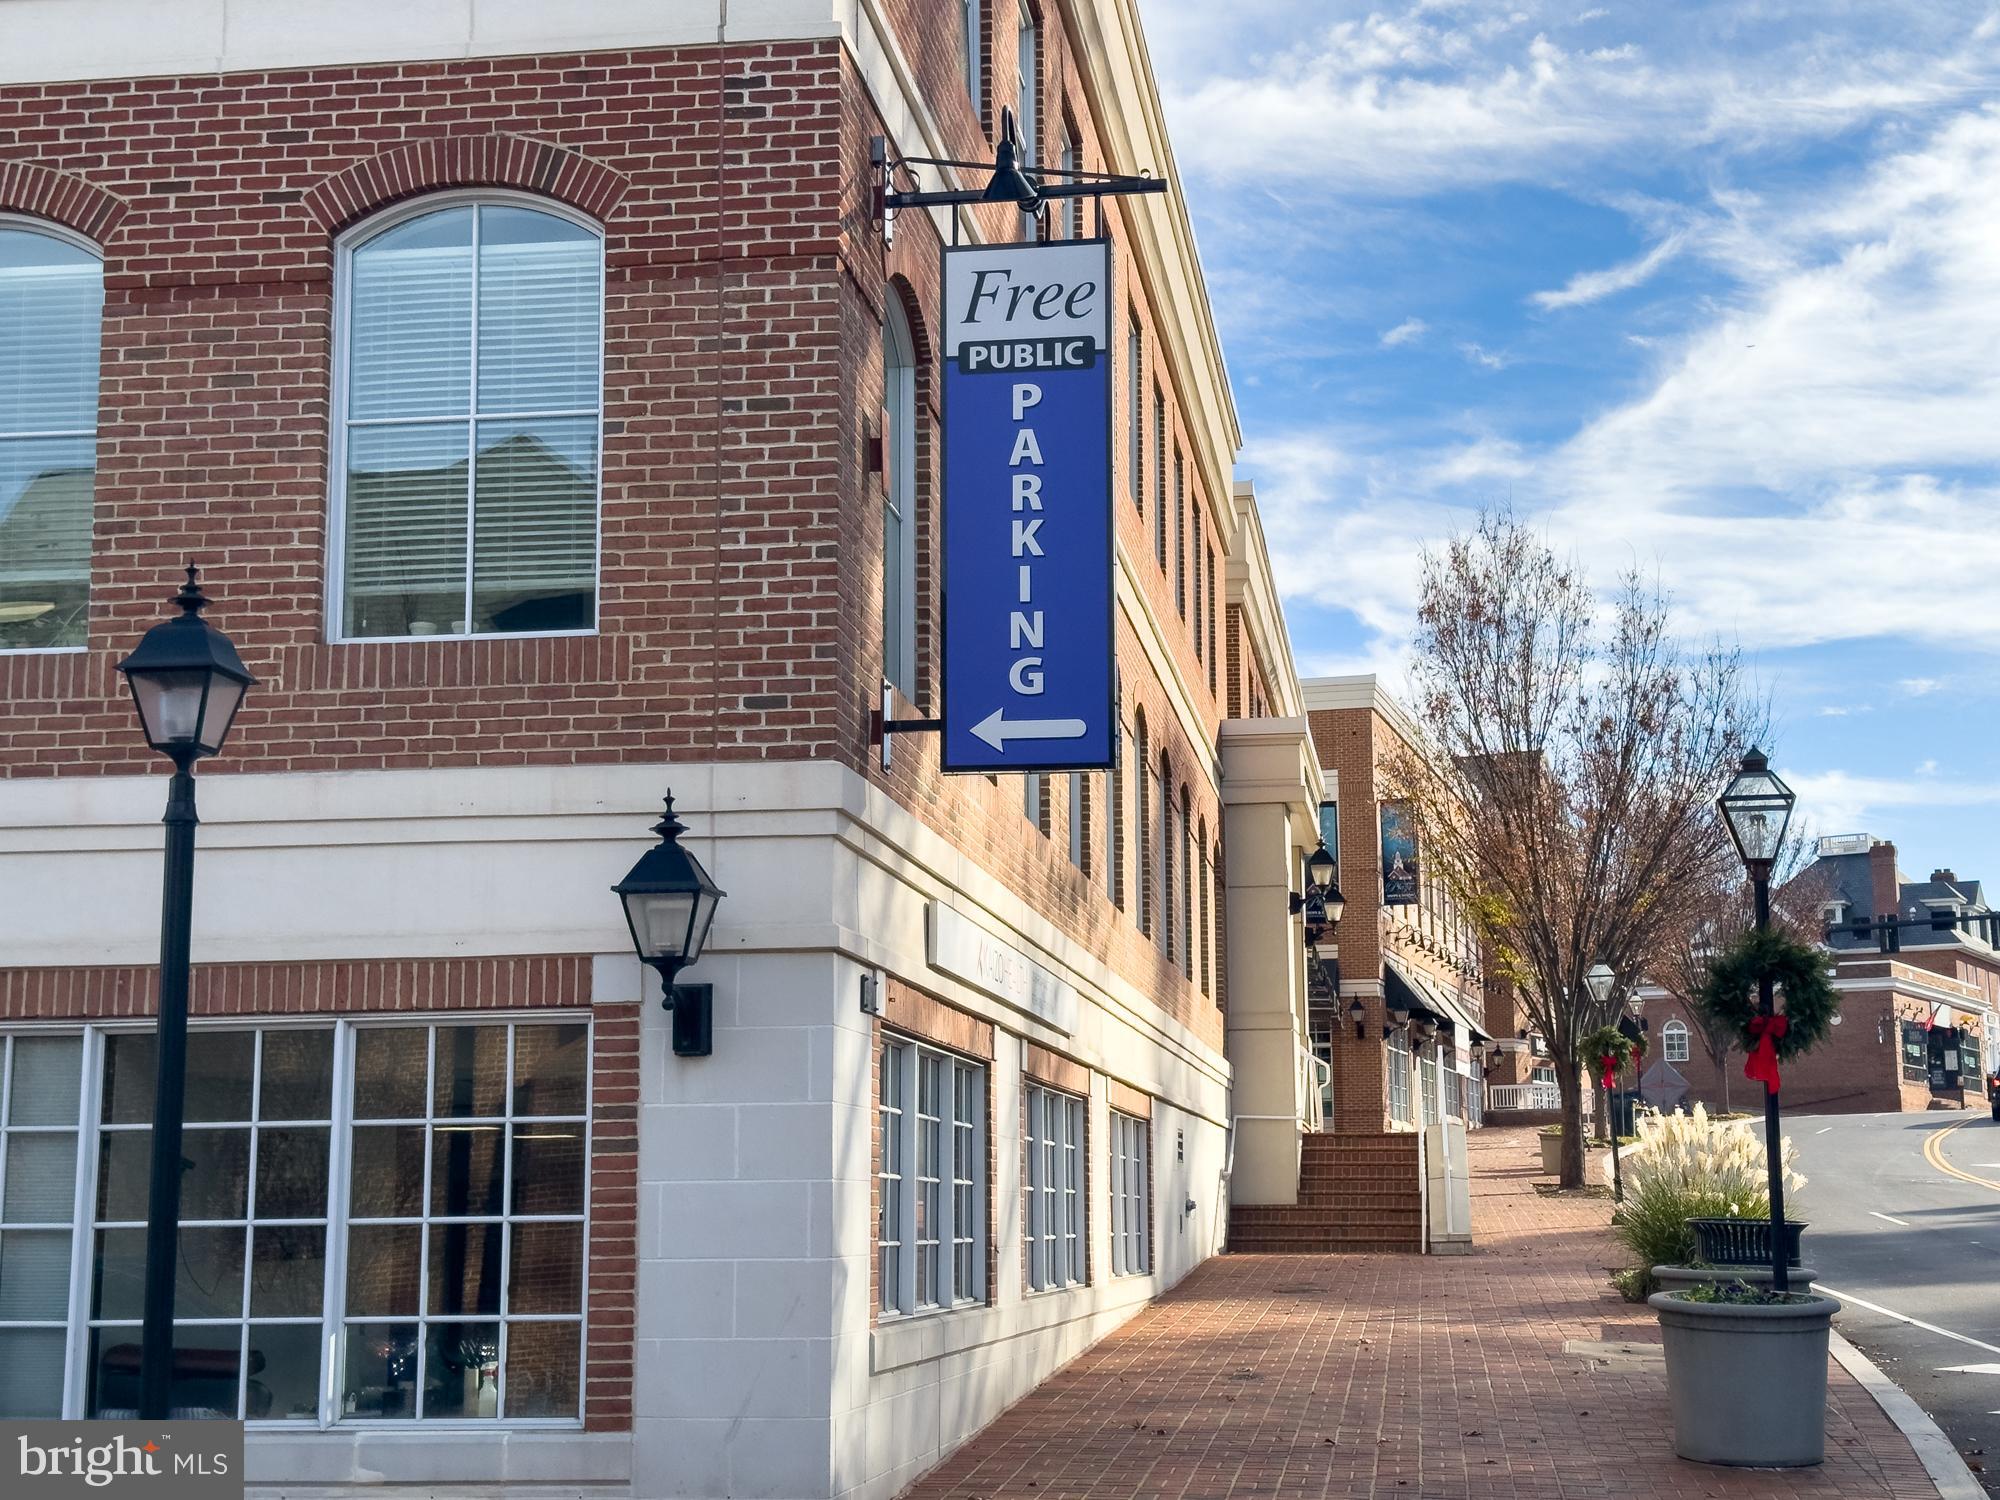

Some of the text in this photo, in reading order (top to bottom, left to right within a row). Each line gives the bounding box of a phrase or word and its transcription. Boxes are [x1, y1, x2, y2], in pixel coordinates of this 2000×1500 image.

[960, 269, 1096, 323] Free
[968, 341, 1085, 370] PUBLIC
[1009, 383, 1045, 695] PARKING
